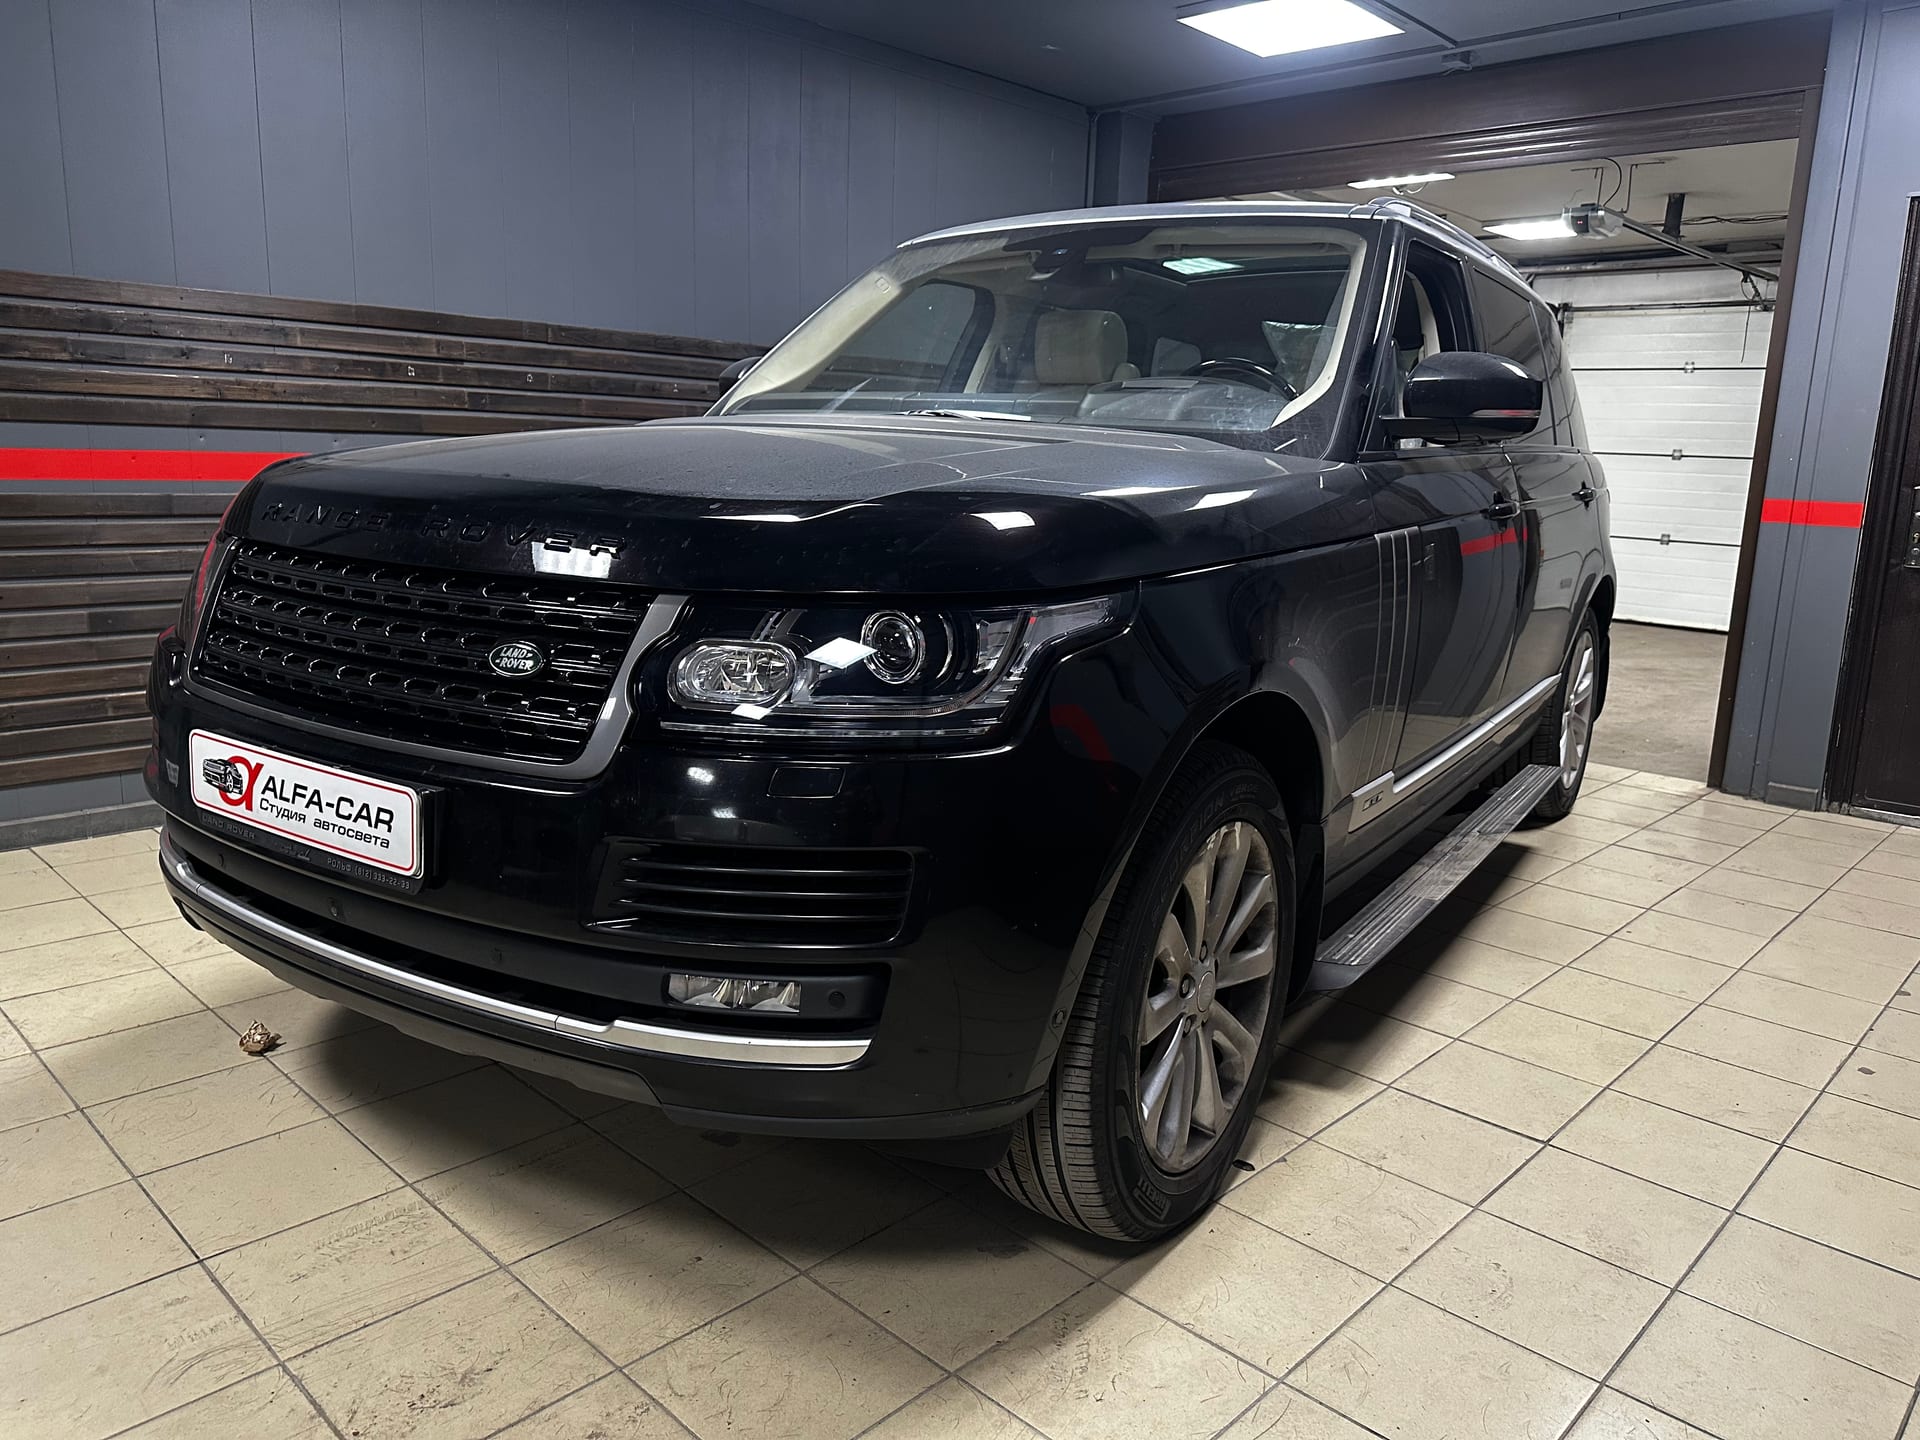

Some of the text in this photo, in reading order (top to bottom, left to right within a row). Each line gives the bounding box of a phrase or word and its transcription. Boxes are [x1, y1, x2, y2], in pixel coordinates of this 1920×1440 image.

[260, 501, 629, 560] RANGE ROVER
[500, 647, 527, 658] LAND
[499, 658, 534, 671] ROVER
[260, 775, 395, 833] ALFA-CAR
[226, 823, 256, 840] ROVER
[259, 798, 390, 849] Студия автосвета
[327, 857, 352, 872] РОЛЬФ
[354, 865, 372, 880] (812)
